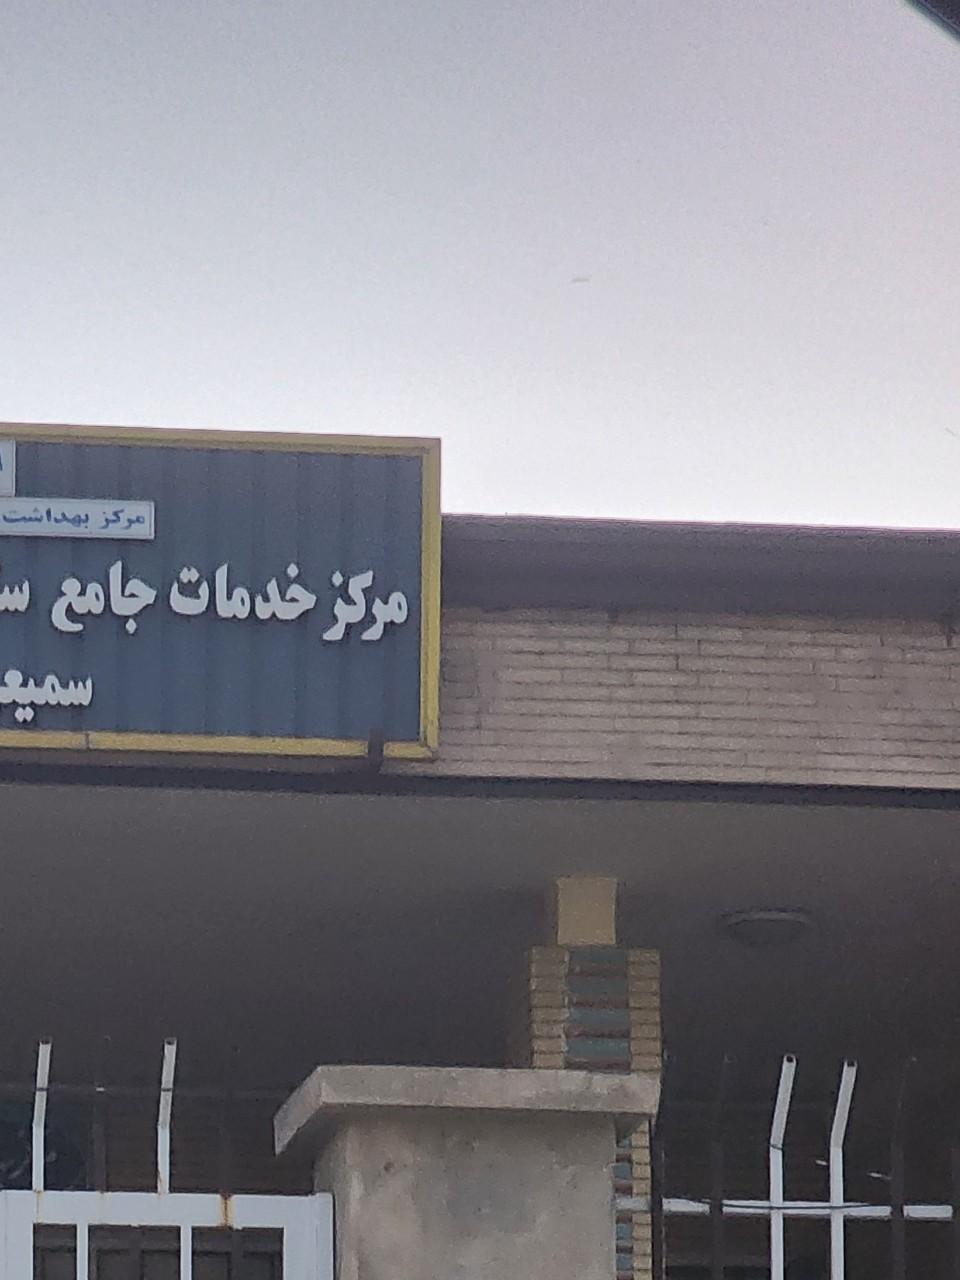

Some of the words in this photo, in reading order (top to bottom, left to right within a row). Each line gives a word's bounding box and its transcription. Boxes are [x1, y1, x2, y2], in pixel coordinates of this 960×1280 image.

[2, 507, 90, 529] بهداشت
[98, 508, 145, 530] مرکز
[52, 559, 157, 634] جامع
[169, 562, 317, 621] خدمات
[322, 569, 408, 641] مرکز
